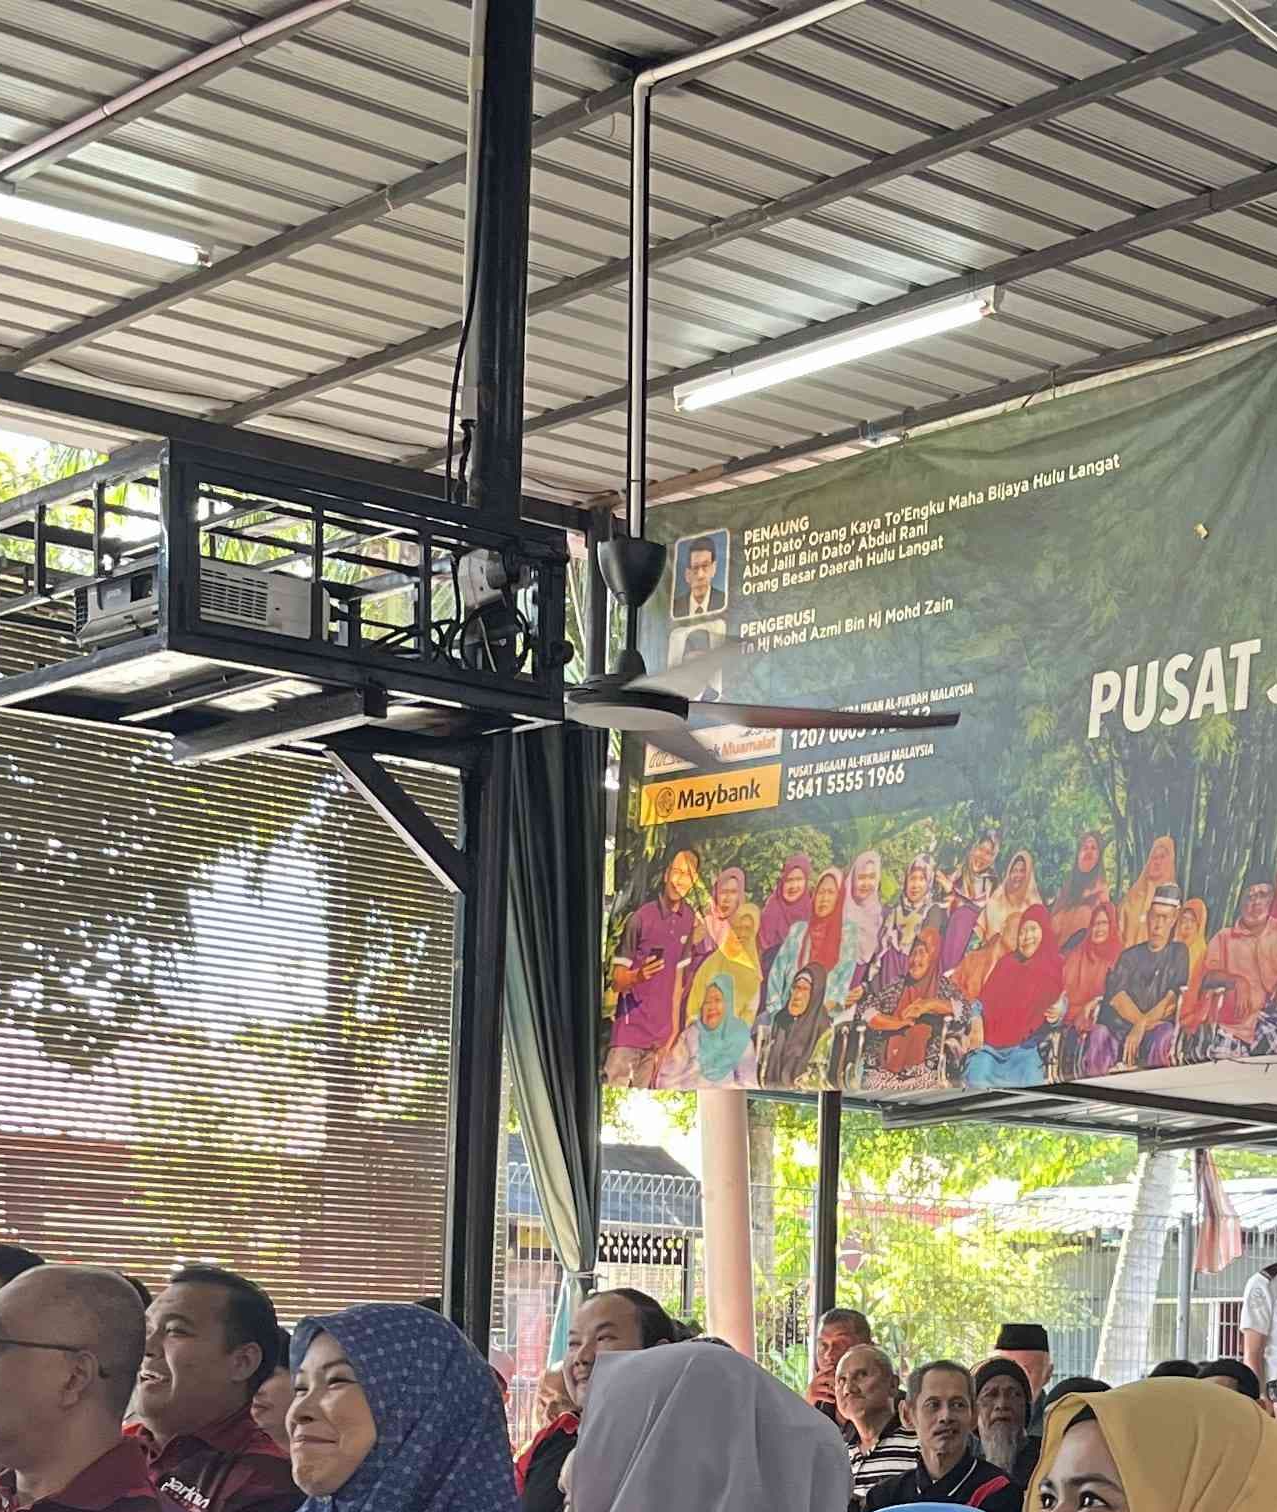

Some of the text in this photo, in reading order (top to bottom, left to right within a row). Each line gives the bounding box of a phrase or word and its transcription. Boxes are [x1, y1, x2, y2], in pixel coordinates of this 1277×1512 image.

[743, 543, 770, 562] YDH
[773, 535, 806, 556] Dato'
[808, 527, 847, 547] Orang
[850, 517, 882, 536] Kaya
[948, 491, 984, 511] Maha
[988, 479, 1029, 501] Bijaya
[1033, 468, 1065, 490] Hulu
[1068, 454, 1121, 481] Langat
[742, 520, 929, 579] Abd Jalil Bin Dato' Abdul Rani
[744, 516, 810, 546] PENAUNG
[742, 535, 945, 596] Orang Besar Daerah Hulu Langat
[740, 608, 816, 638] PENGERUSI
[757, 637, 770, 653] Hj
[773, 628, 807, 650] Mohd
[810, 622, 842, 641] Azmi
[844, 616, 865, 633] Bin
[868, 612, 882, 630] Hj
[885, 602, 921, 625] Mohd
[924, 596, 954, 616] Zain
[930, 682, 975, 702] MALAYSIA
[1087, 639, 1263, 740] PUSAT
[788, 744, 934, 778] PUSAT JAGAAN AL-FIKRAH MALAYSIA
[677, 778, 761, 811] Maybank
[786, 762, 905, 801] 5641 5555 1966
